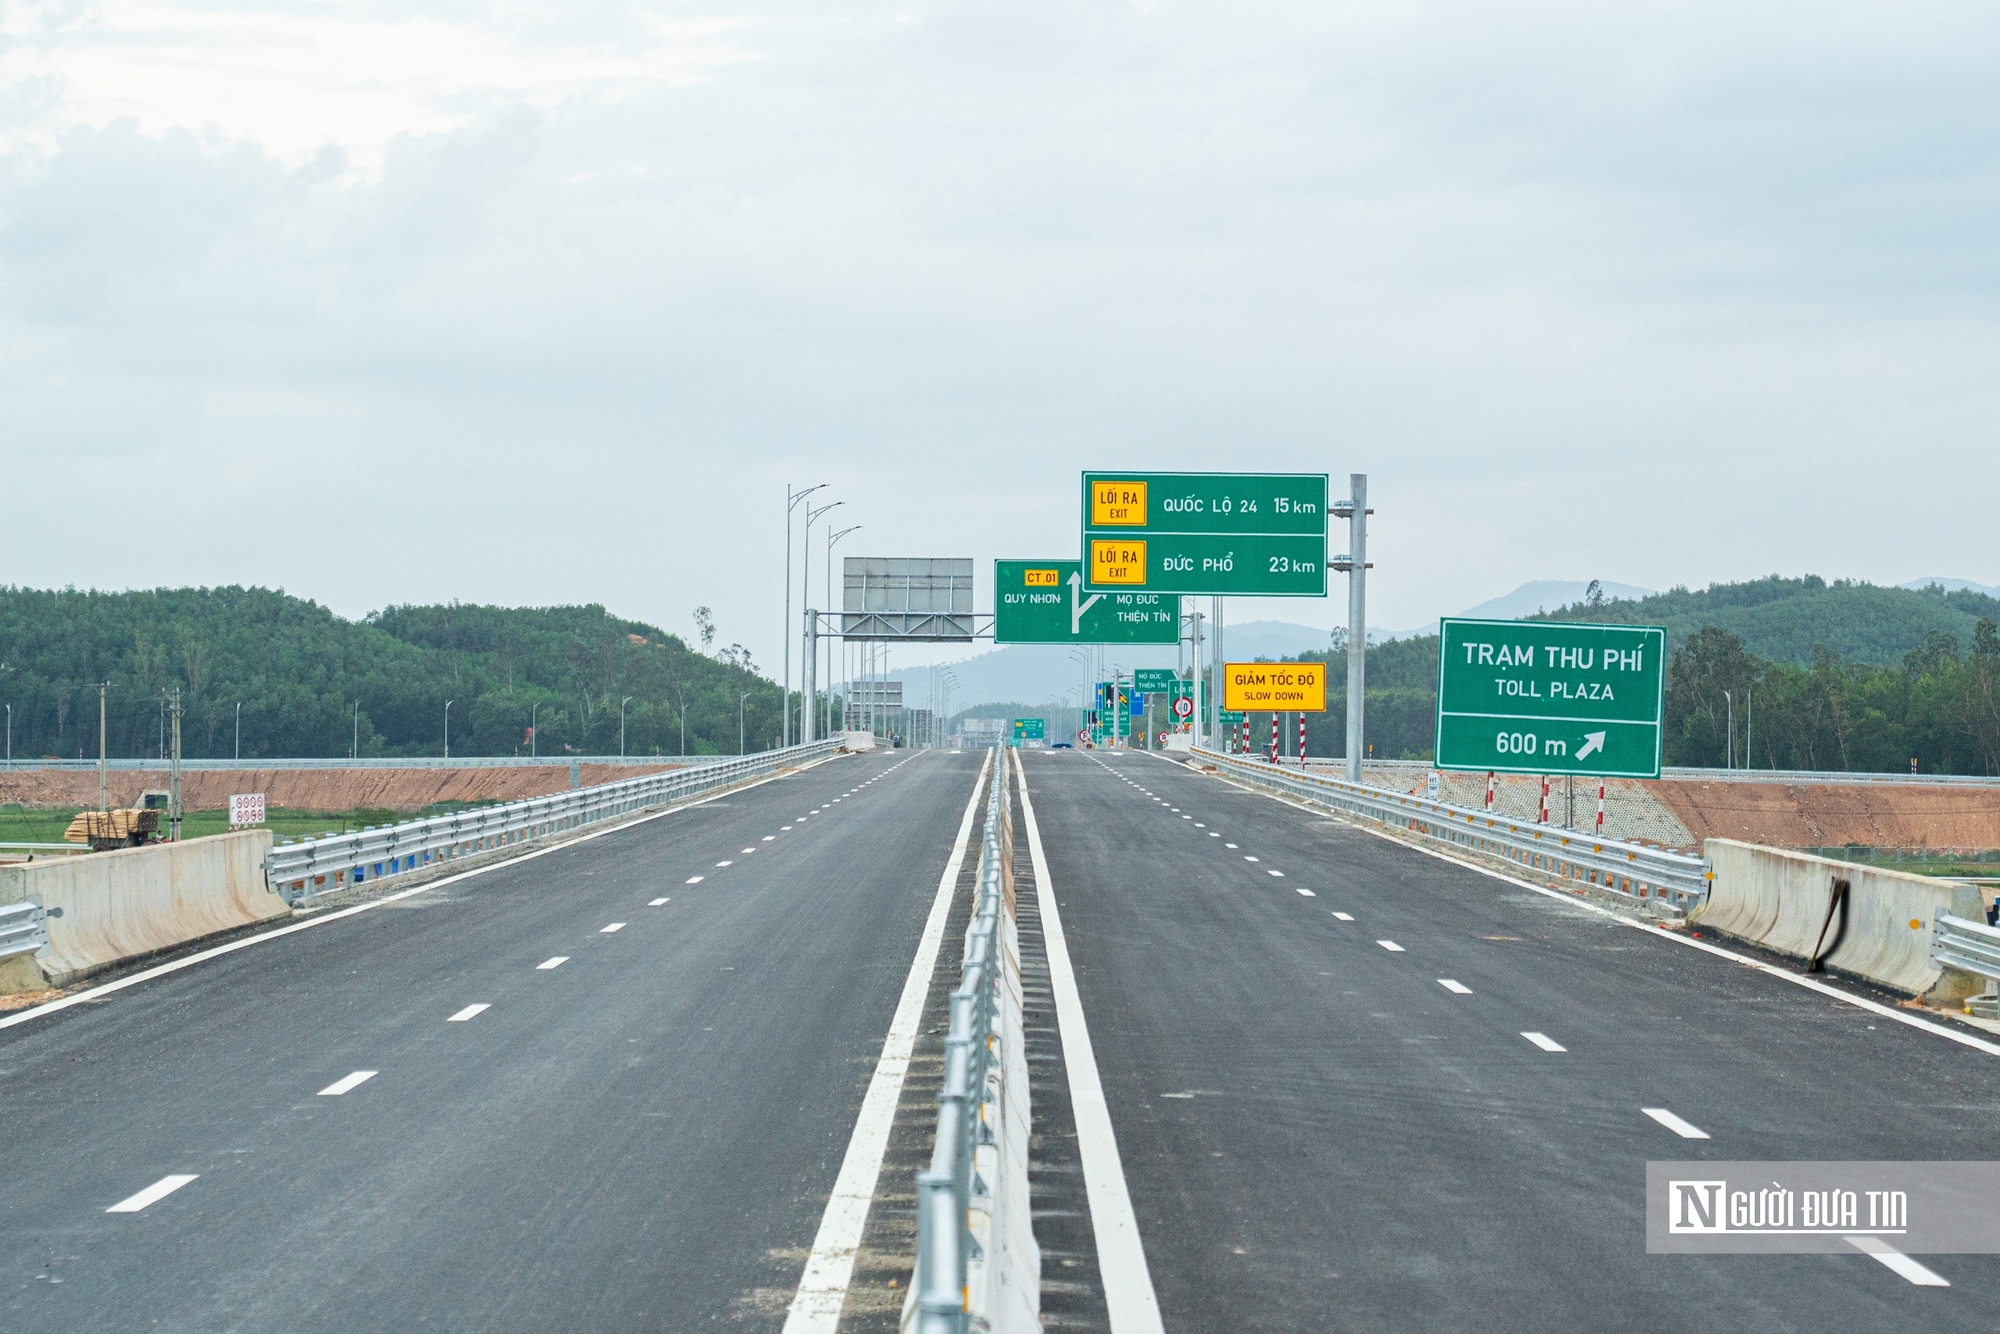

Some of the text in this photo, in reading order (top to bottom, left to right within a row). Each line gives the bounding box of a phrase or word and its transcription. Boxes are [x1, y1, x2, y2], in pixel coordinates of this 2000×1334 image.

[1100, 487, 1138, 505] LỐI RA
[1163, 493, 1316, 516] QUỐC LỘ 24 15 km
[1110, 508, 1128, 519] EXIT
[1099, 546, 1138, 563] LỐI RA
[1163, 551, 1315, 573] ĐỨC PHỔ 23 km
[1109, 567, 1127, 578] EXIT
[1004, 593, 1027, 604] QUY
[1117, 609, 1171, 624] THIỆN TÍN
[1462, 642, 1645, 672] TRẠM THU PHÍ
[1235, 669, 1315, 688] GIẢM TỐC ĐỘ
[1244, 691, 1304, 701] SLOW DOWN
[1495, 678, 1614, 701] TOLL PLAZA
[1496, 731, 1567, 756] 600 m
